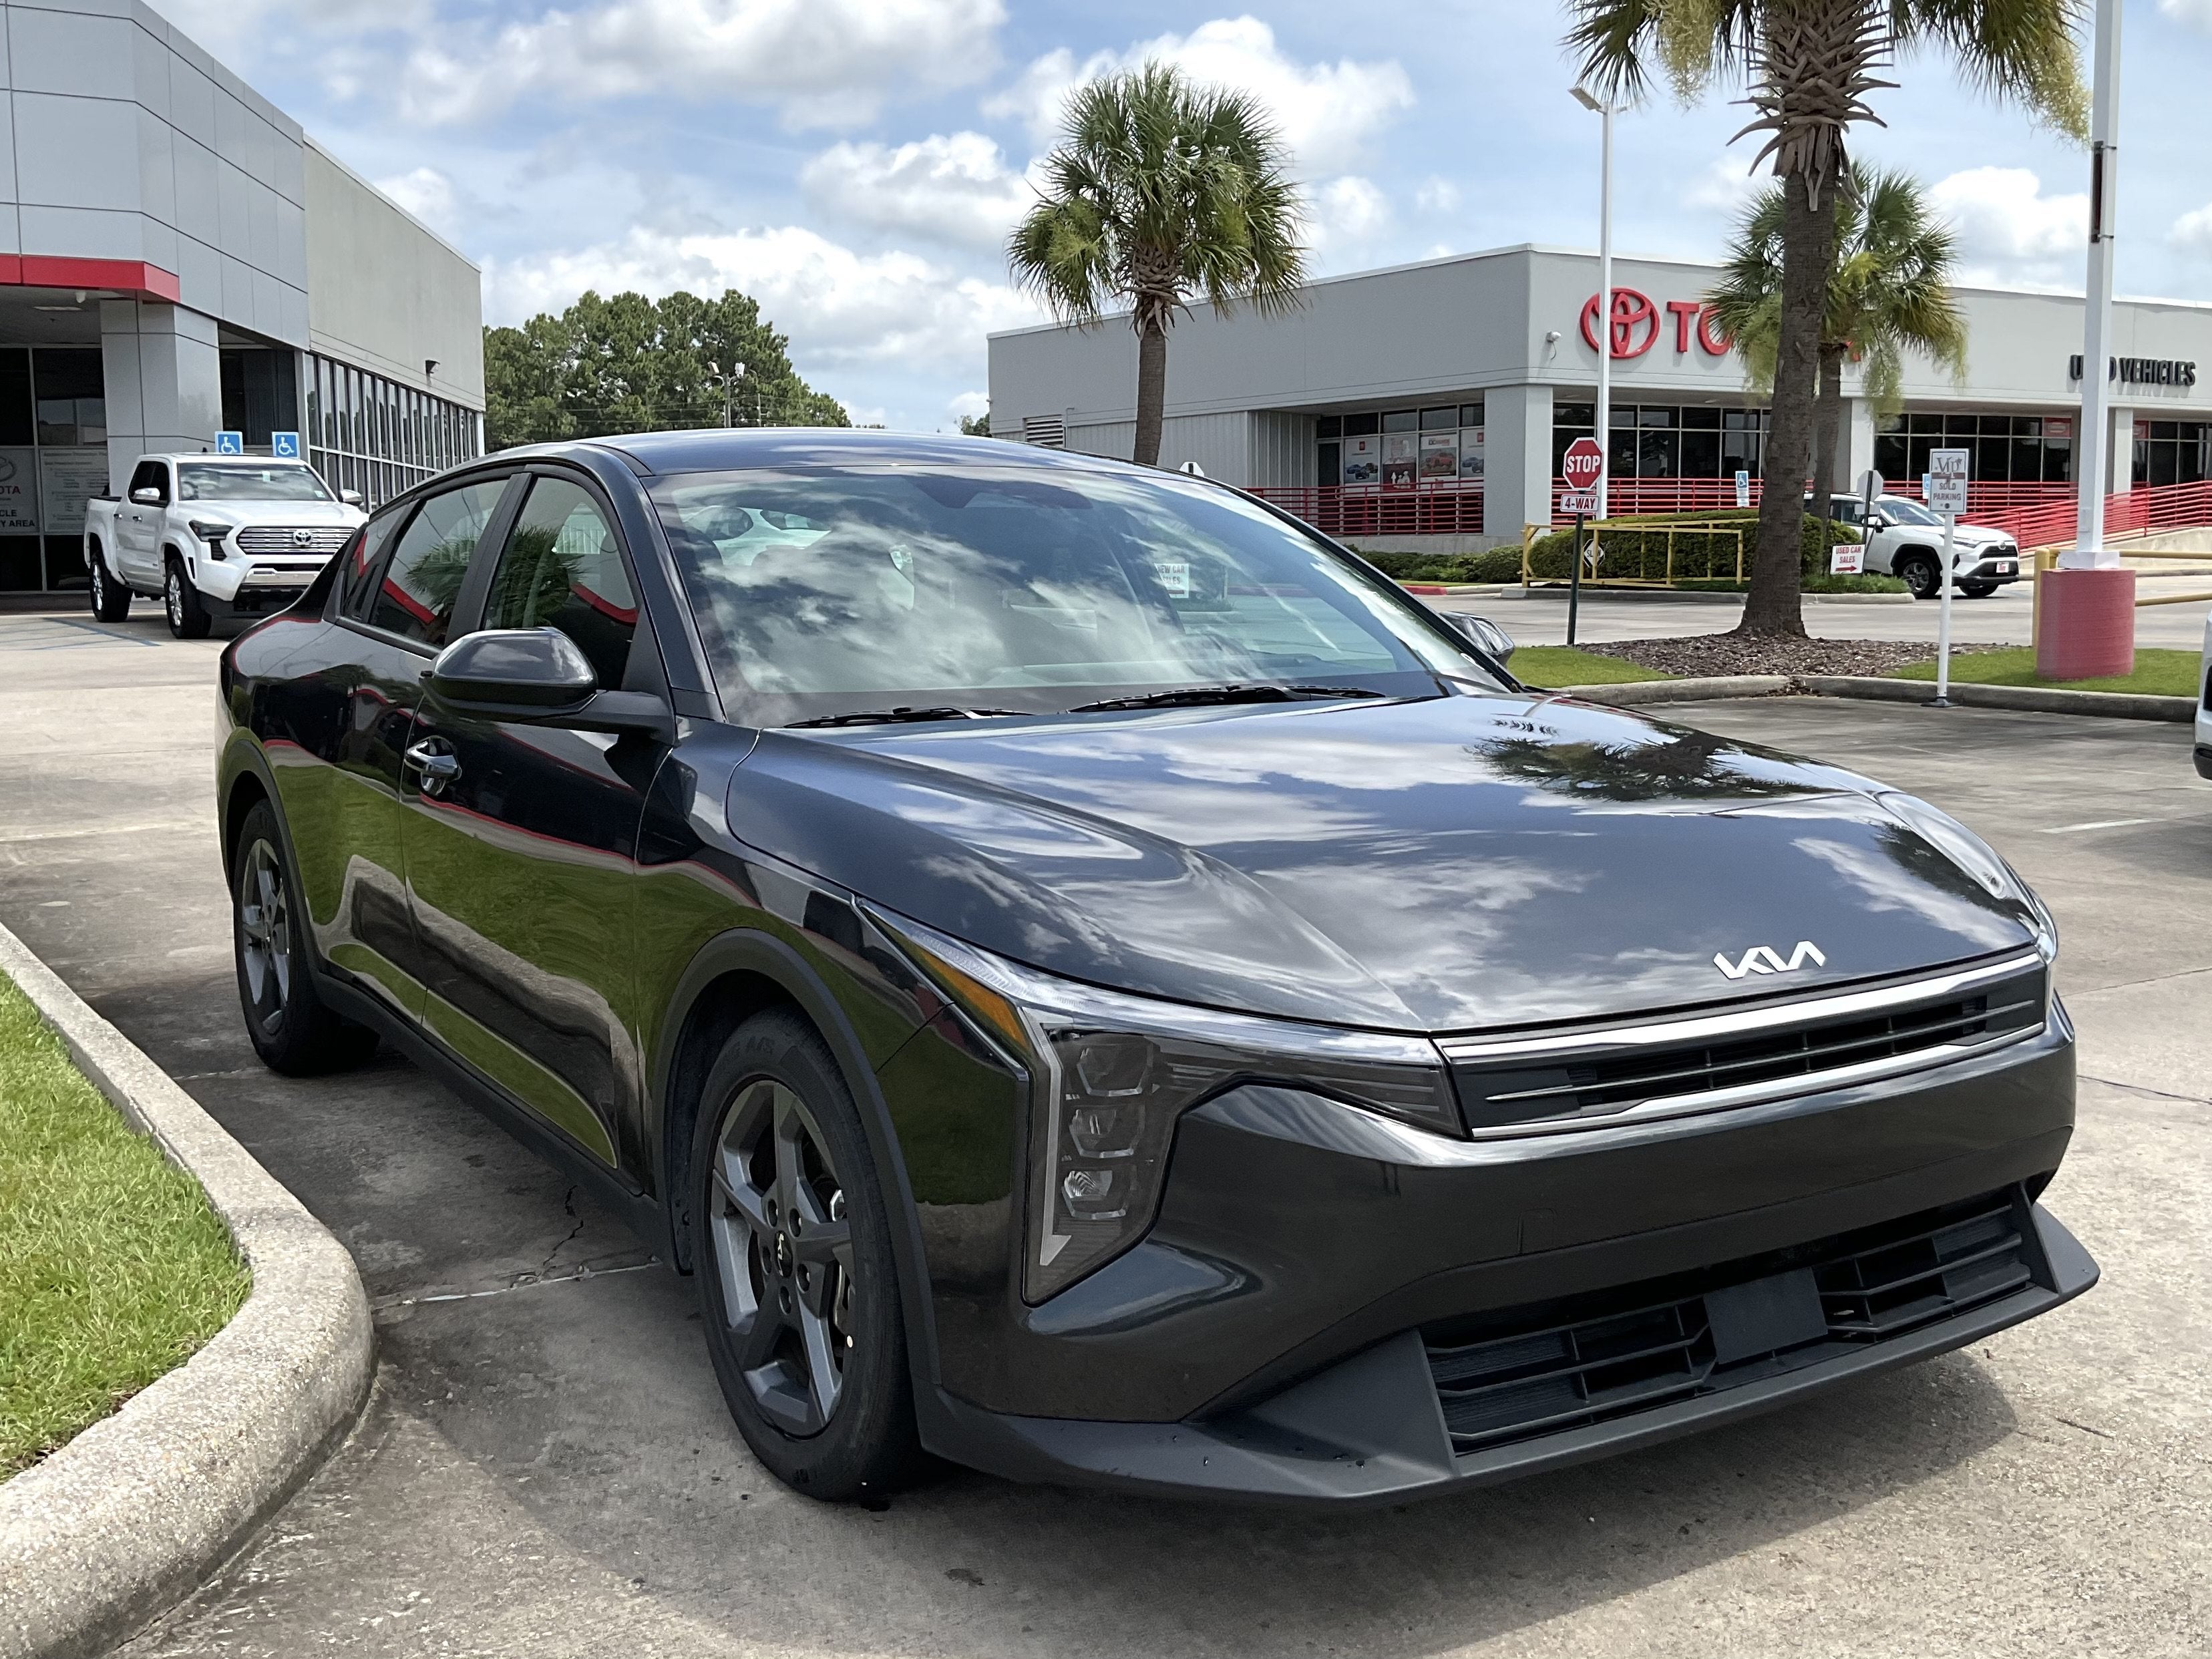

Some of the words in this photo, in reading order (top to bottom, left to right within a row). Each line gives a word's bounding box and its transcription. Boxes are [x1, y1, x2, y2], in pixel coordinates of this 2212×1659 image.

[2070, 355, 2116, 381] UD
[2119, 357, 2196, 387] VEHICLES
[1566, 455, 1601, 473] STOP
[1933, 493, 1962, 501] PARKING
[1565, 498, 1596, 509] 4-WAY
[1835, 546, 1849, 554] USED
[1839, 556, 1855, 564] SALES
[1172, 565, 1185, 573] CAR
[1713, 940, 1826, 980] KIA
